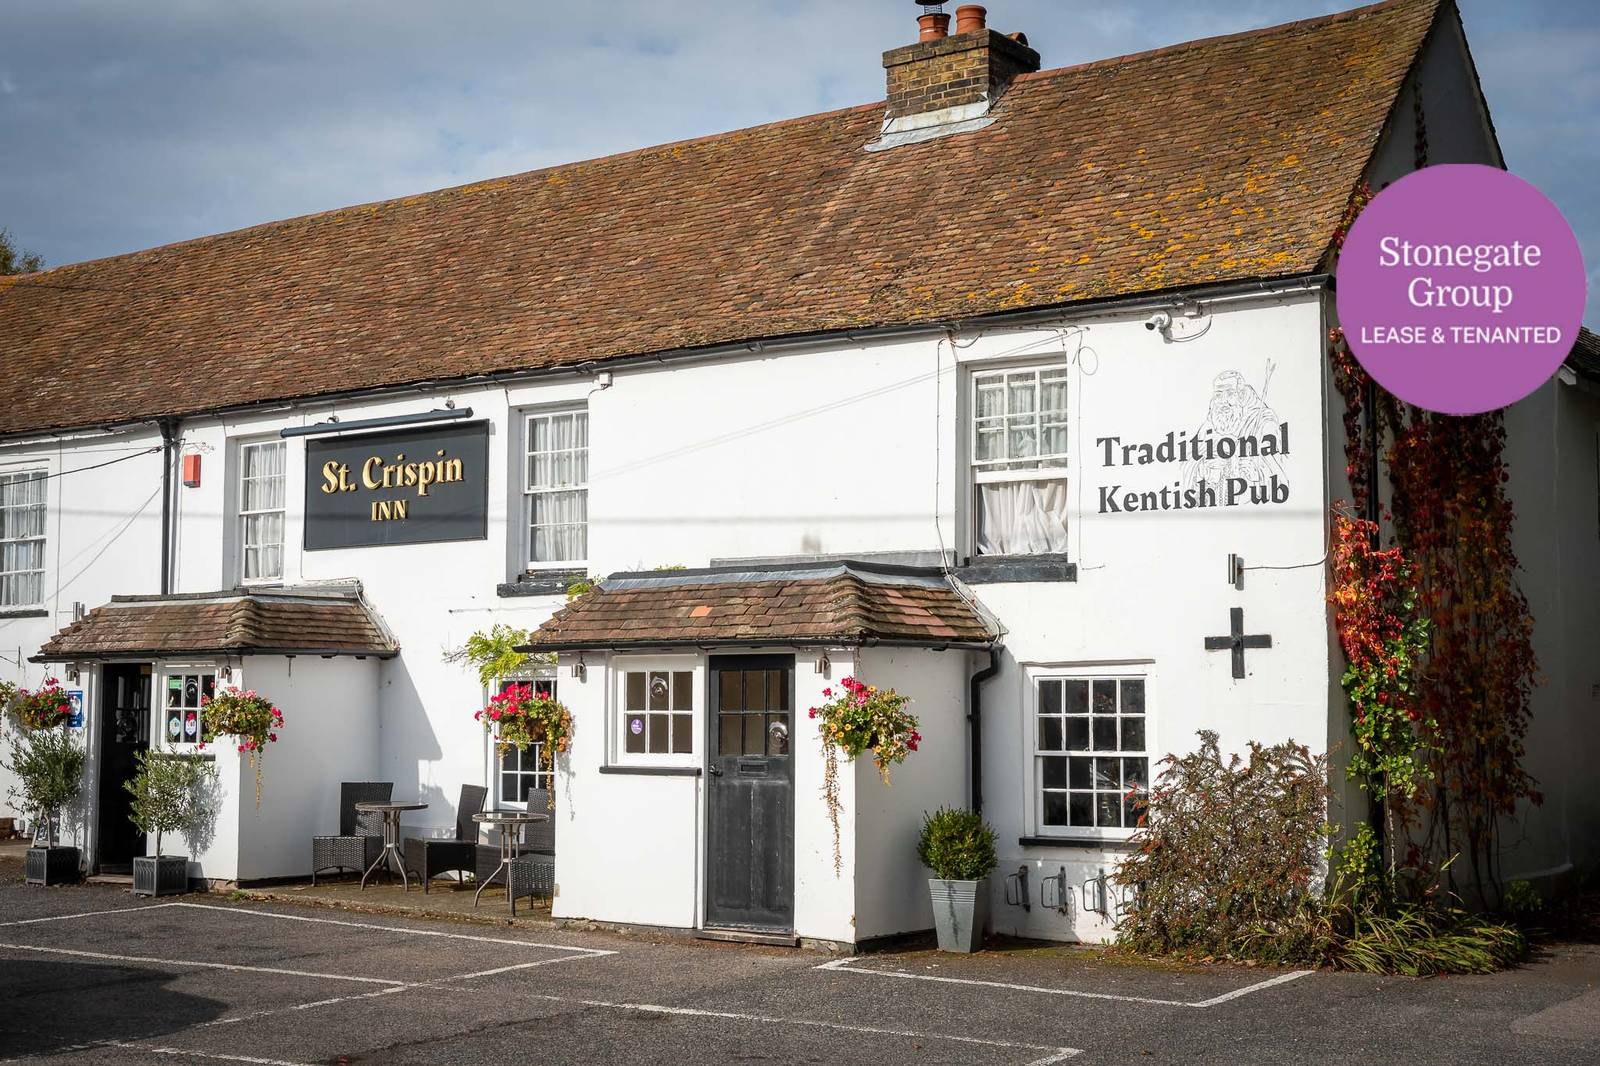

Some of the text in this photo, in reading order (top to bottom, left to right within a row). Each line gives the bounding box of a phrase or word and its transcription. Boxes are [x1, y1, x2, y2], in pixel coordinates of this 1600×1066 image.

[1096, 421, 1290, 467] Traditional
[321, 449, 464, 497] St. Crispin
[1097, 474, 1290, 514] Kentish Pub
[370, 499, 409, 522] INN
